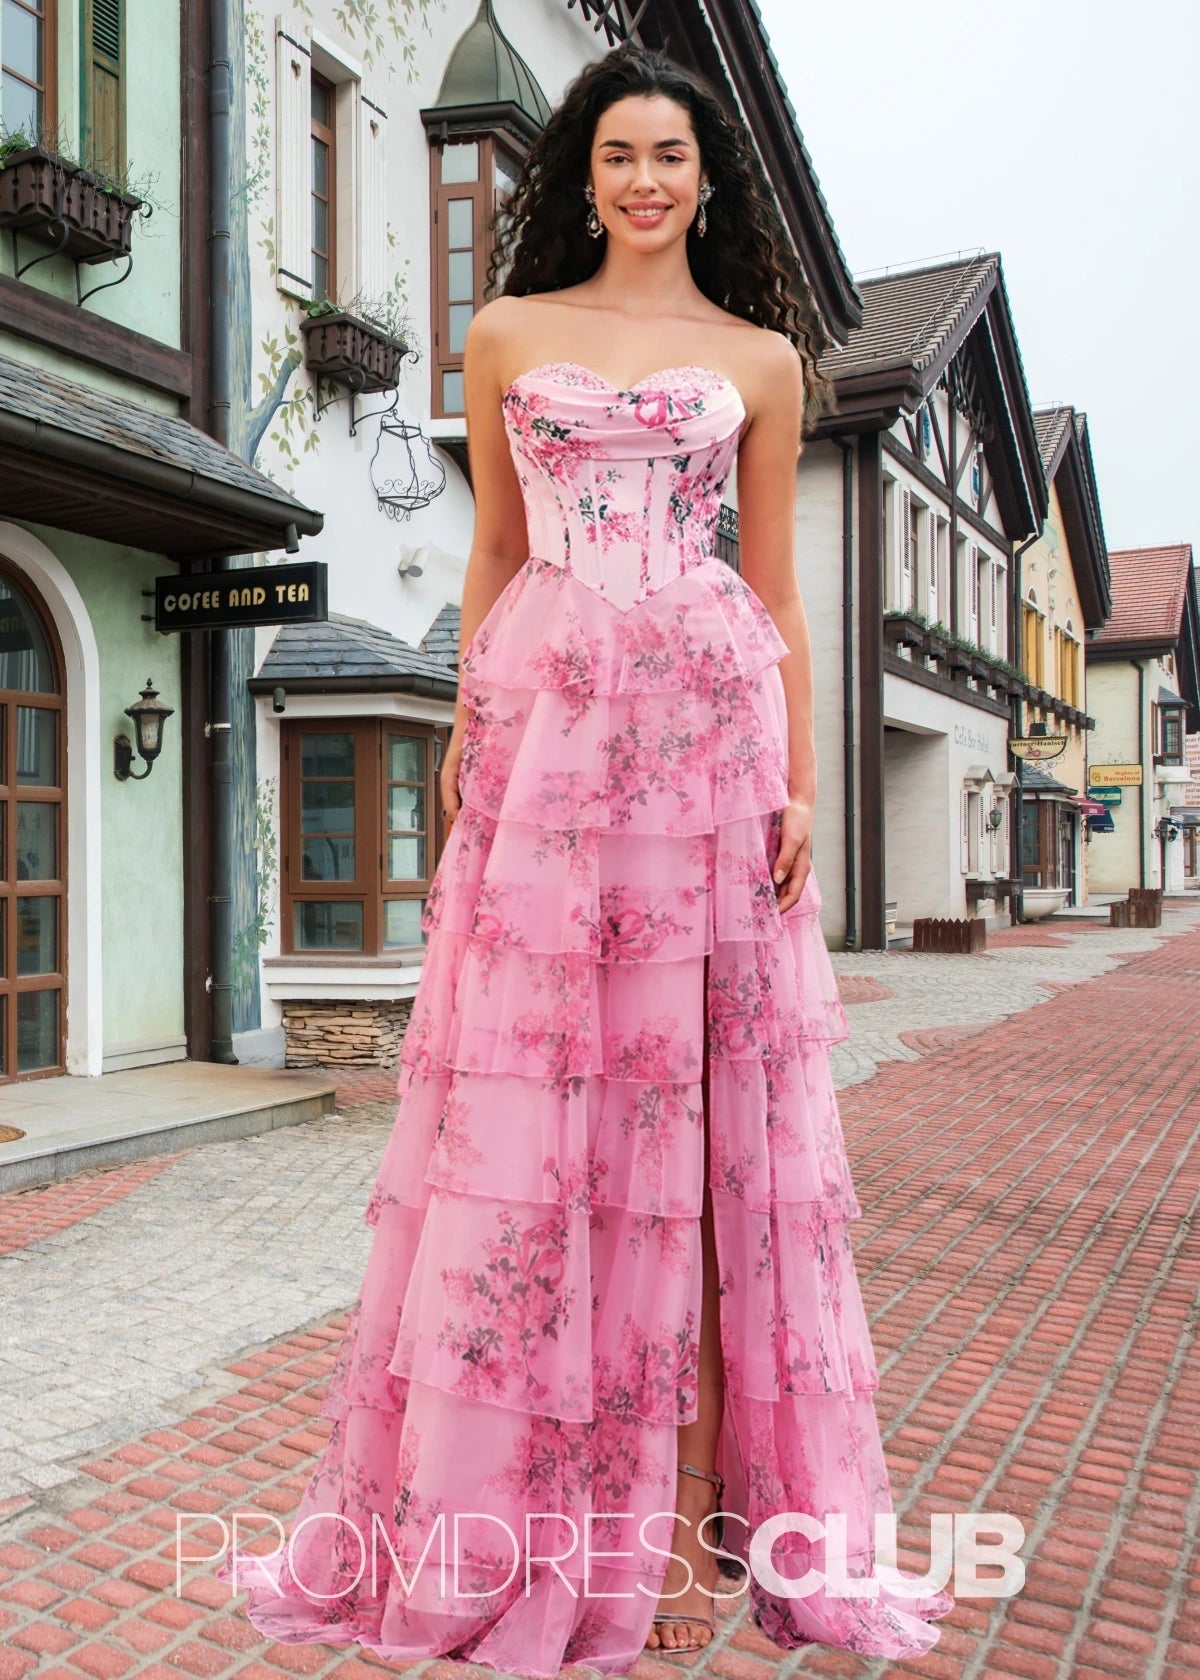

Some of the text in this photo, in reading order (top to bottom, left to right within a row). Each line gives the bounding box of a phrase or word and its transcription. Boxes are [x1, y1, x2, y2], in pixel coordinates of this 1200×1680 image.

[164, 583, 309, 612] COFEE AND TEA
